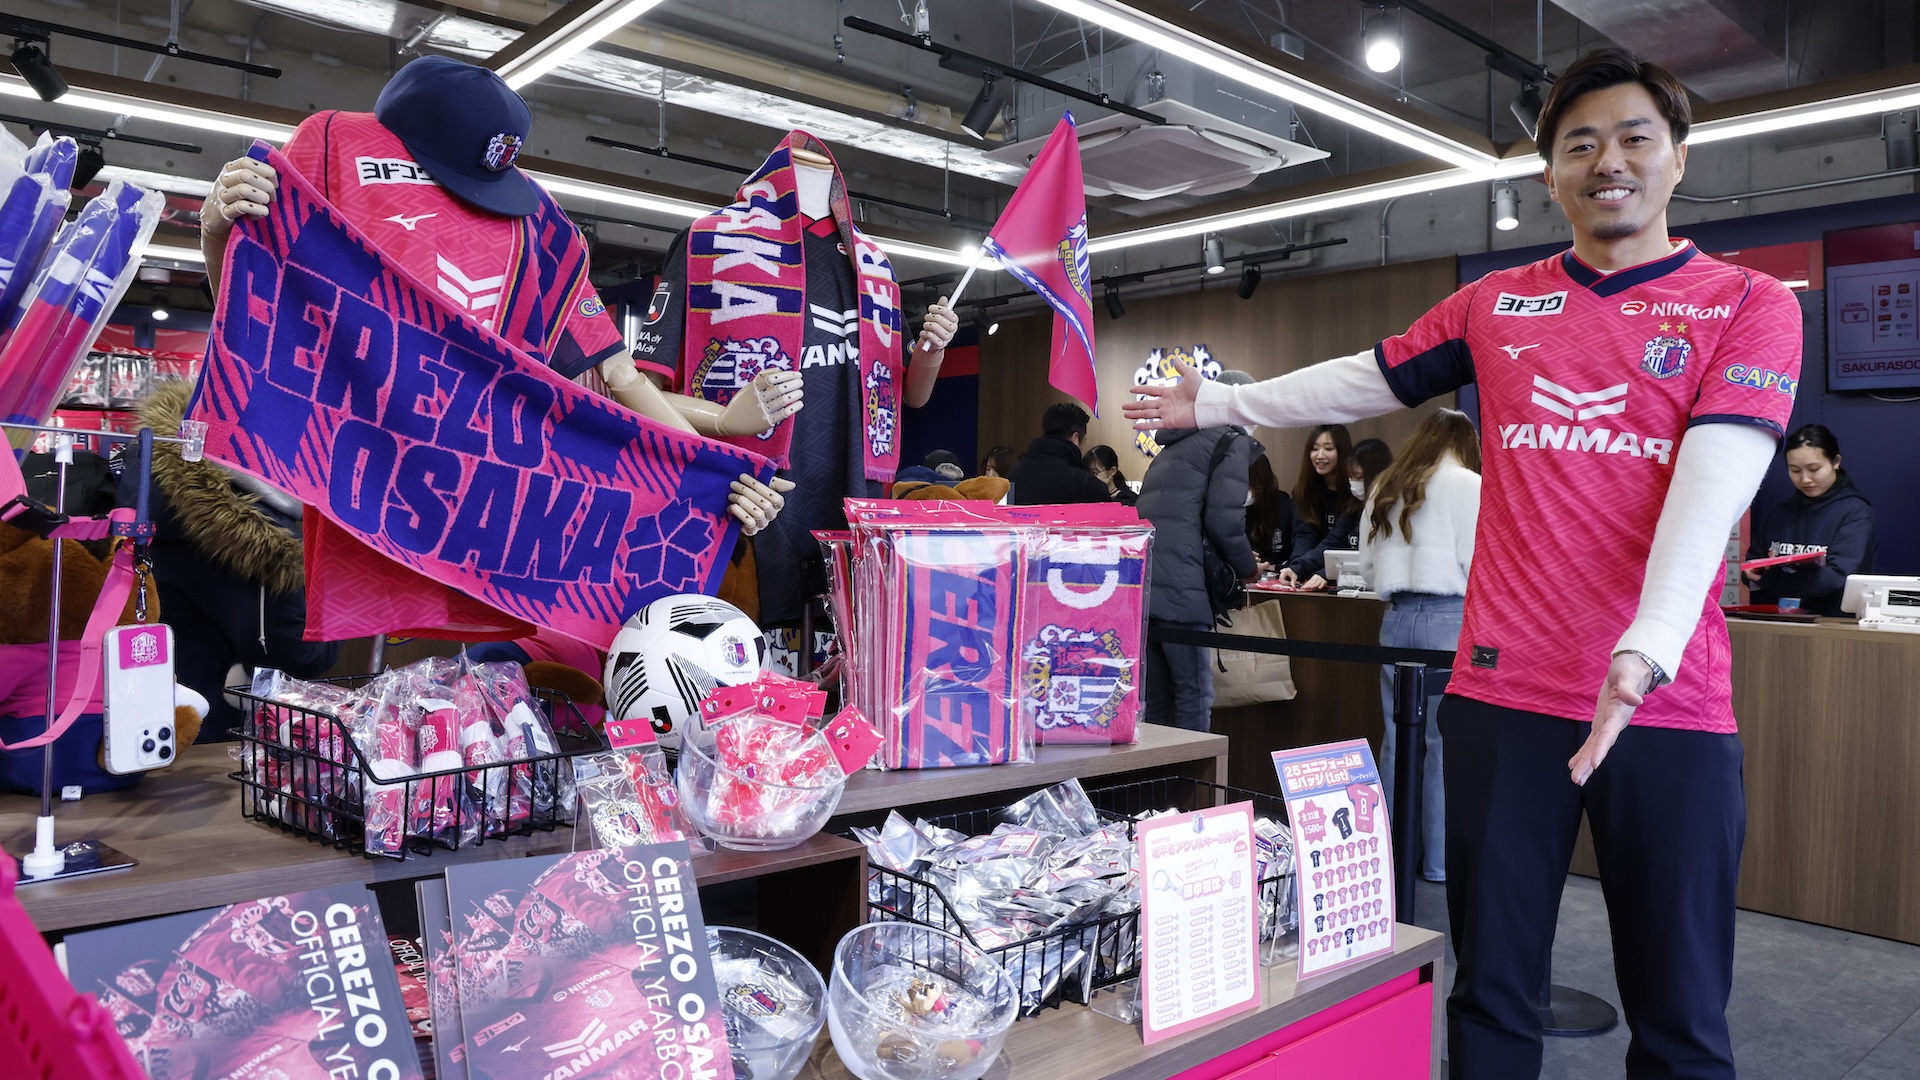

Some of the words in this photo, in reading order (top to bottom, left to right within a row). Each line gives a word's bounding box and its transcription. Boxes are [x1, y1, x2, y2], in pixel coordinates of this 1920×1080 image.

[1065, 251, 1080, 287] CEREZO
[1498, 296, 1562, 313] ヨドコウ
[1651, 302, 1731, 320] NIKKON
[219, 236, 557, 469] CEREZO
[328, 417, 635, 586] OSAKA
[1498, 424, 1674, 465] YANMAR
[290, 910, 345, 1041] OFFICIAL
[325, 903, 387, 1047] CEREZO
[623, 860, 662, 972] OFFICIAL
[652, 856, 698, 983] CEREZO
